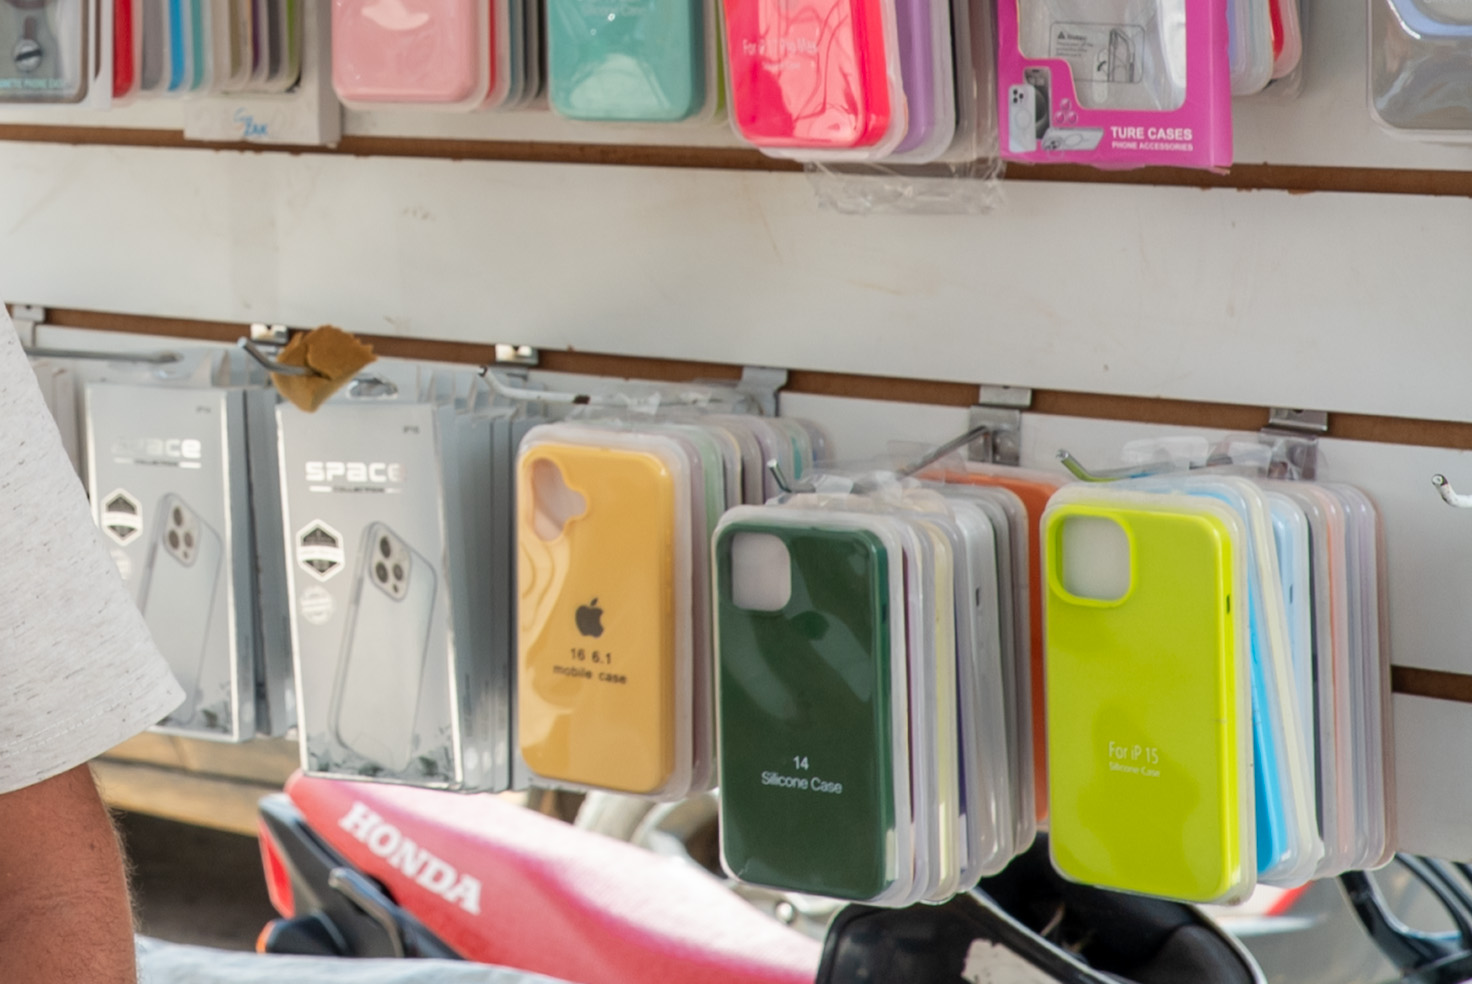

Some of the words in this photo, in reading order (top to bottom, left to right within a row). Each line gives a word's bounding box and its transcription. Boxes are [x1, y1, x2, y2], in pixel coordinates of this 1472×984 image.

[1110, 126, 1145, 139] TURE
[1147, 127, 1193, 141] CASES
[1111, 141, 1137, 150] PHONE
[1139, 142, 1194, 152] ACCESSORIES
[570, 647, 586, 662] 16
[591, 650, 612, 665] 6.1
[553, 664, 592, 679] mobile
[598, 671, 627, 685] case
[1108, 740, 1128, 759] For
[1145, 747, 1159, 765] 15
[793, 755, 809, 771] 14
[761, 770, 808, 790] Silicone
[810, 776, 843, 794] Case
[337, 800, 483, 916] HONDA
